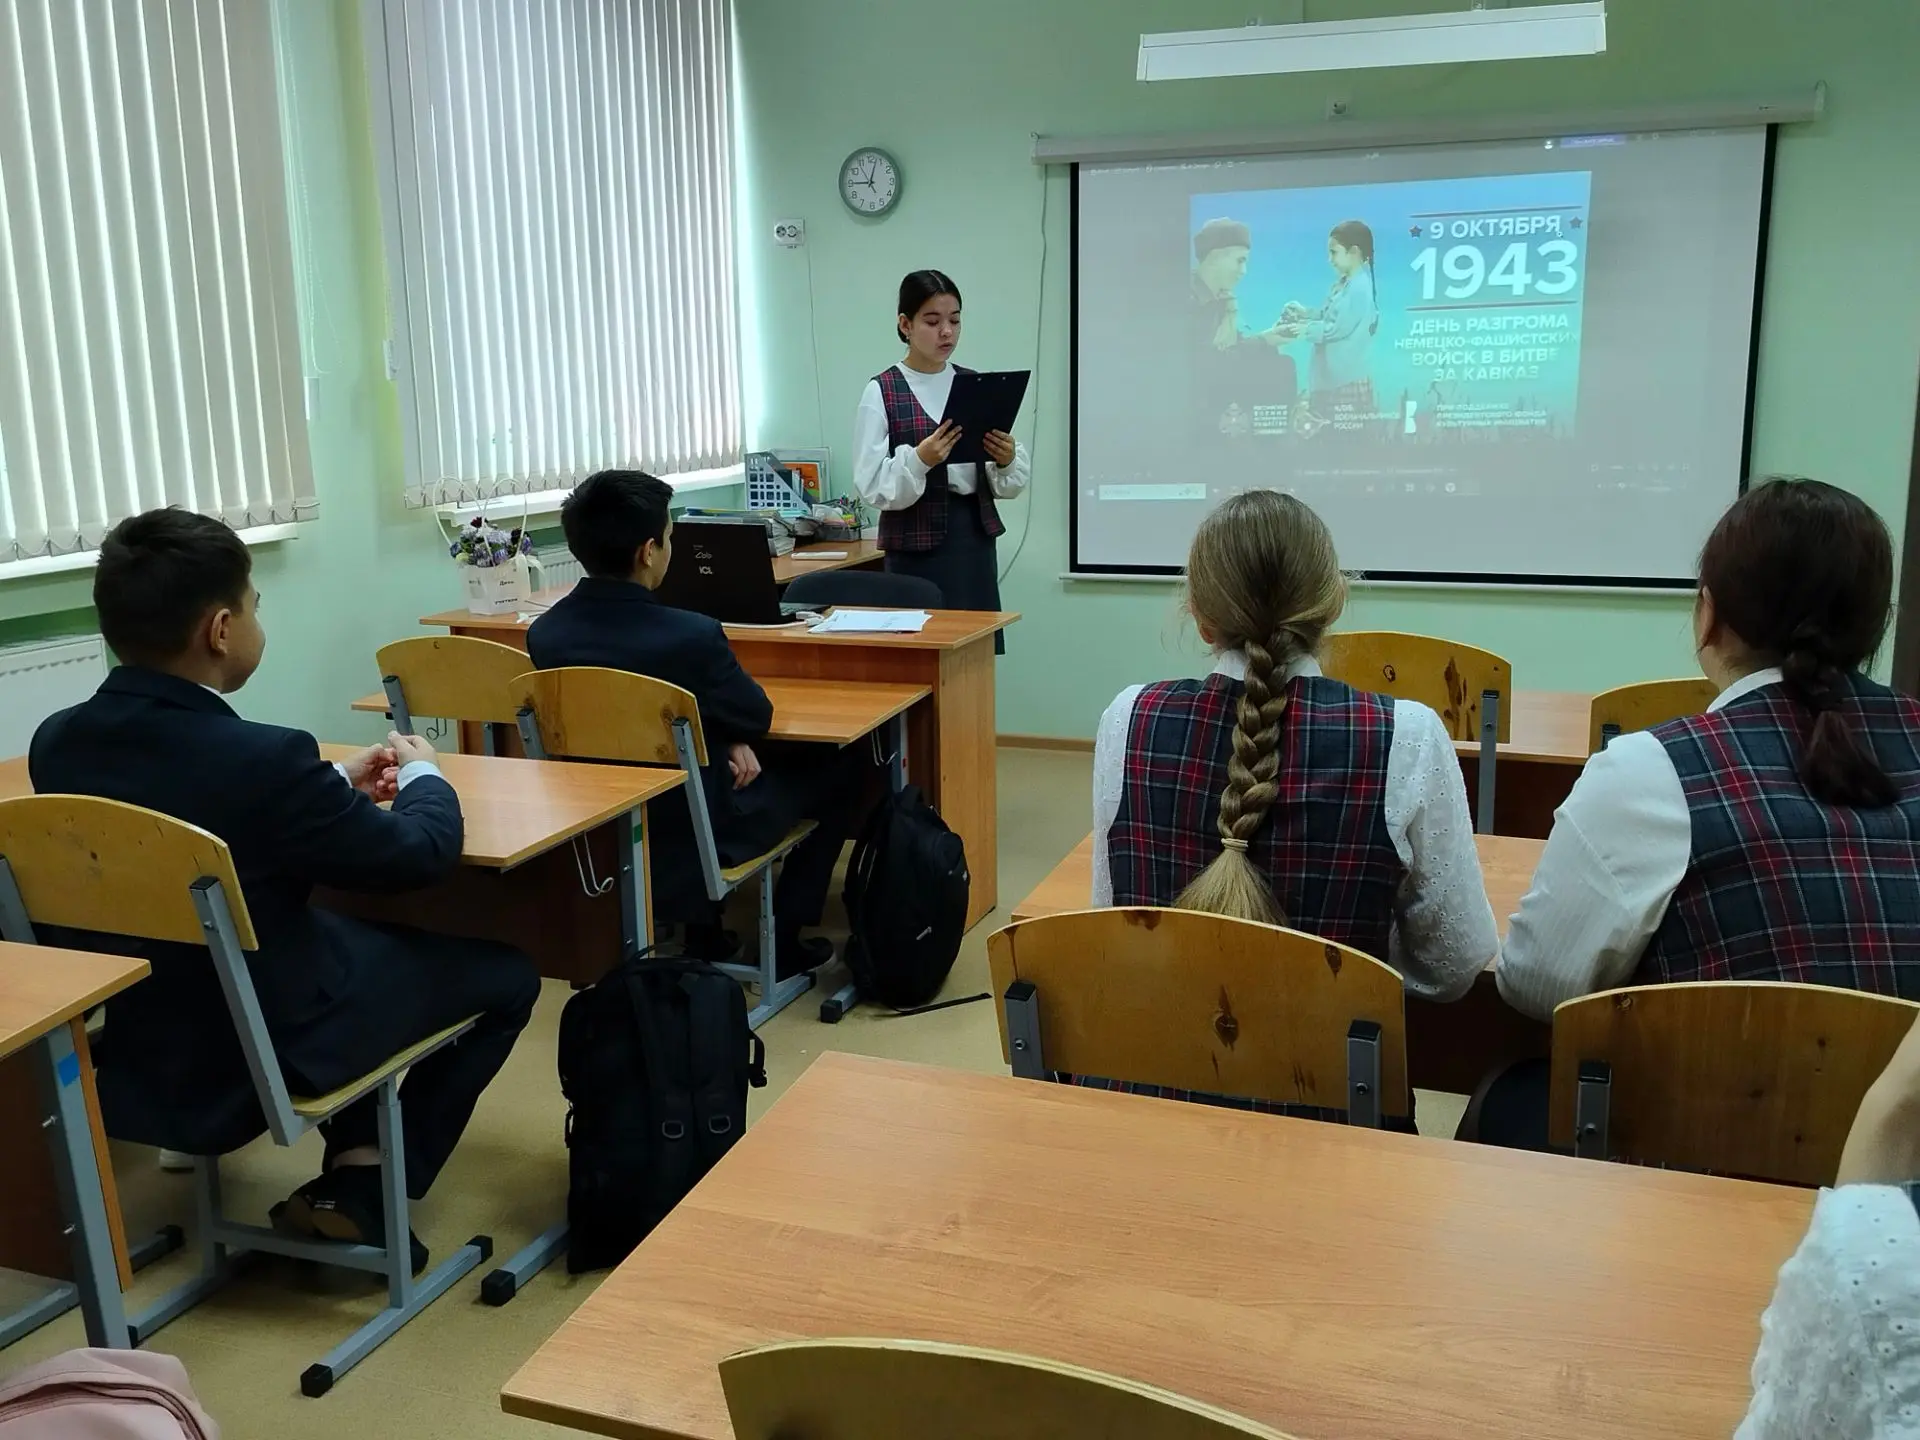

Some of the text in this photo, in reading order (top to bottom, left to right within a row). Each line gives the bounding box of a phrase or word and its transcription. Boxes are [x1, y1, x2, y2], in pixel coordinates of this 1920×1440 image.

[1430, 215, 1561, 239] 9 ОКТЯБРЯ
[1409, 239, 1578, 300] 1943
[1410, 313, 1568, 336] ДЕНЬ РАЗГРОМА
[1412, 349, 1475, 366] ВОЙСК
[1481, 350, 1494, 364] В
[1434, 367, 1457, 381] ЗА
